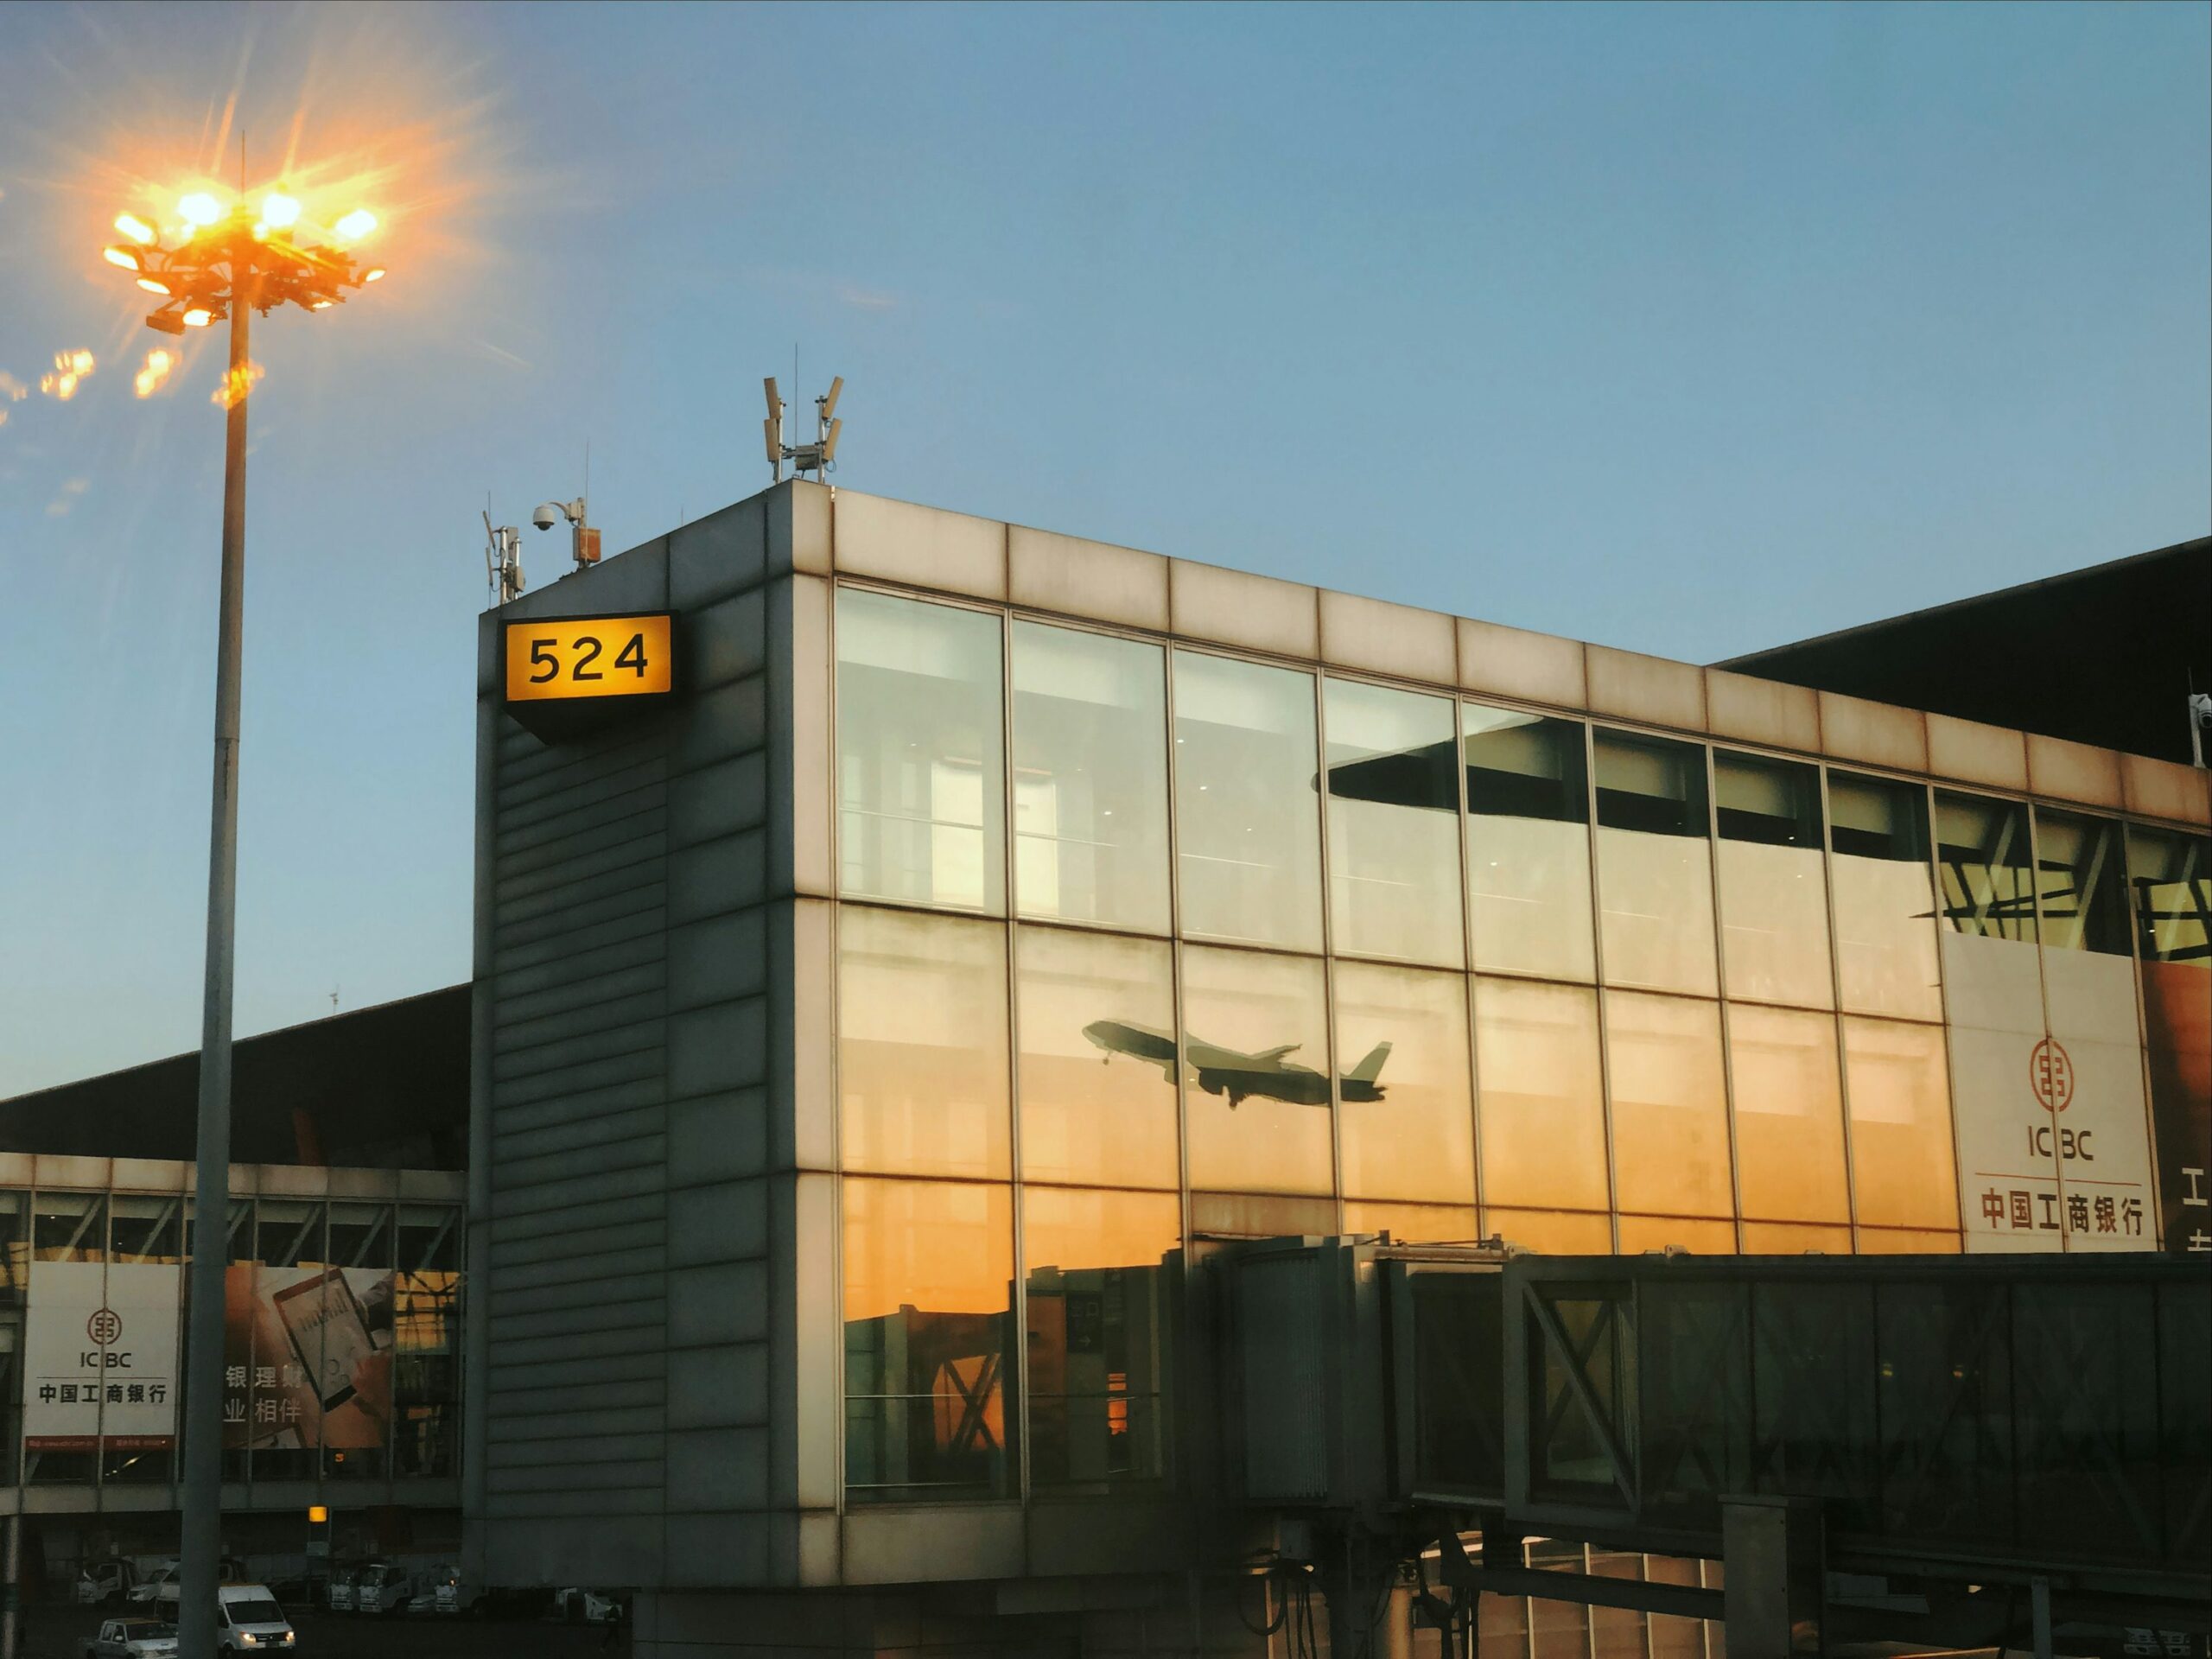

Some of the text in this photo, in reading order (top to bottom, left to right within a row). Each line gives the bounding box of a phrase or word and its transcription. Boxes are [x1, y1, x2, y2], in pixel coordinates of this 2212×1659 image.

[530, 633, 648, 683] 524
[2028, 1126, 2094, 1160] ICBC
[1982, 1187, 2143, 1236] 中国工商银行
[80, 1353, 132, 1368] ICBC
[39, 1383, 166, 1404] 中国工商银行
[223, 1398, 302, 1423] 业相伴
